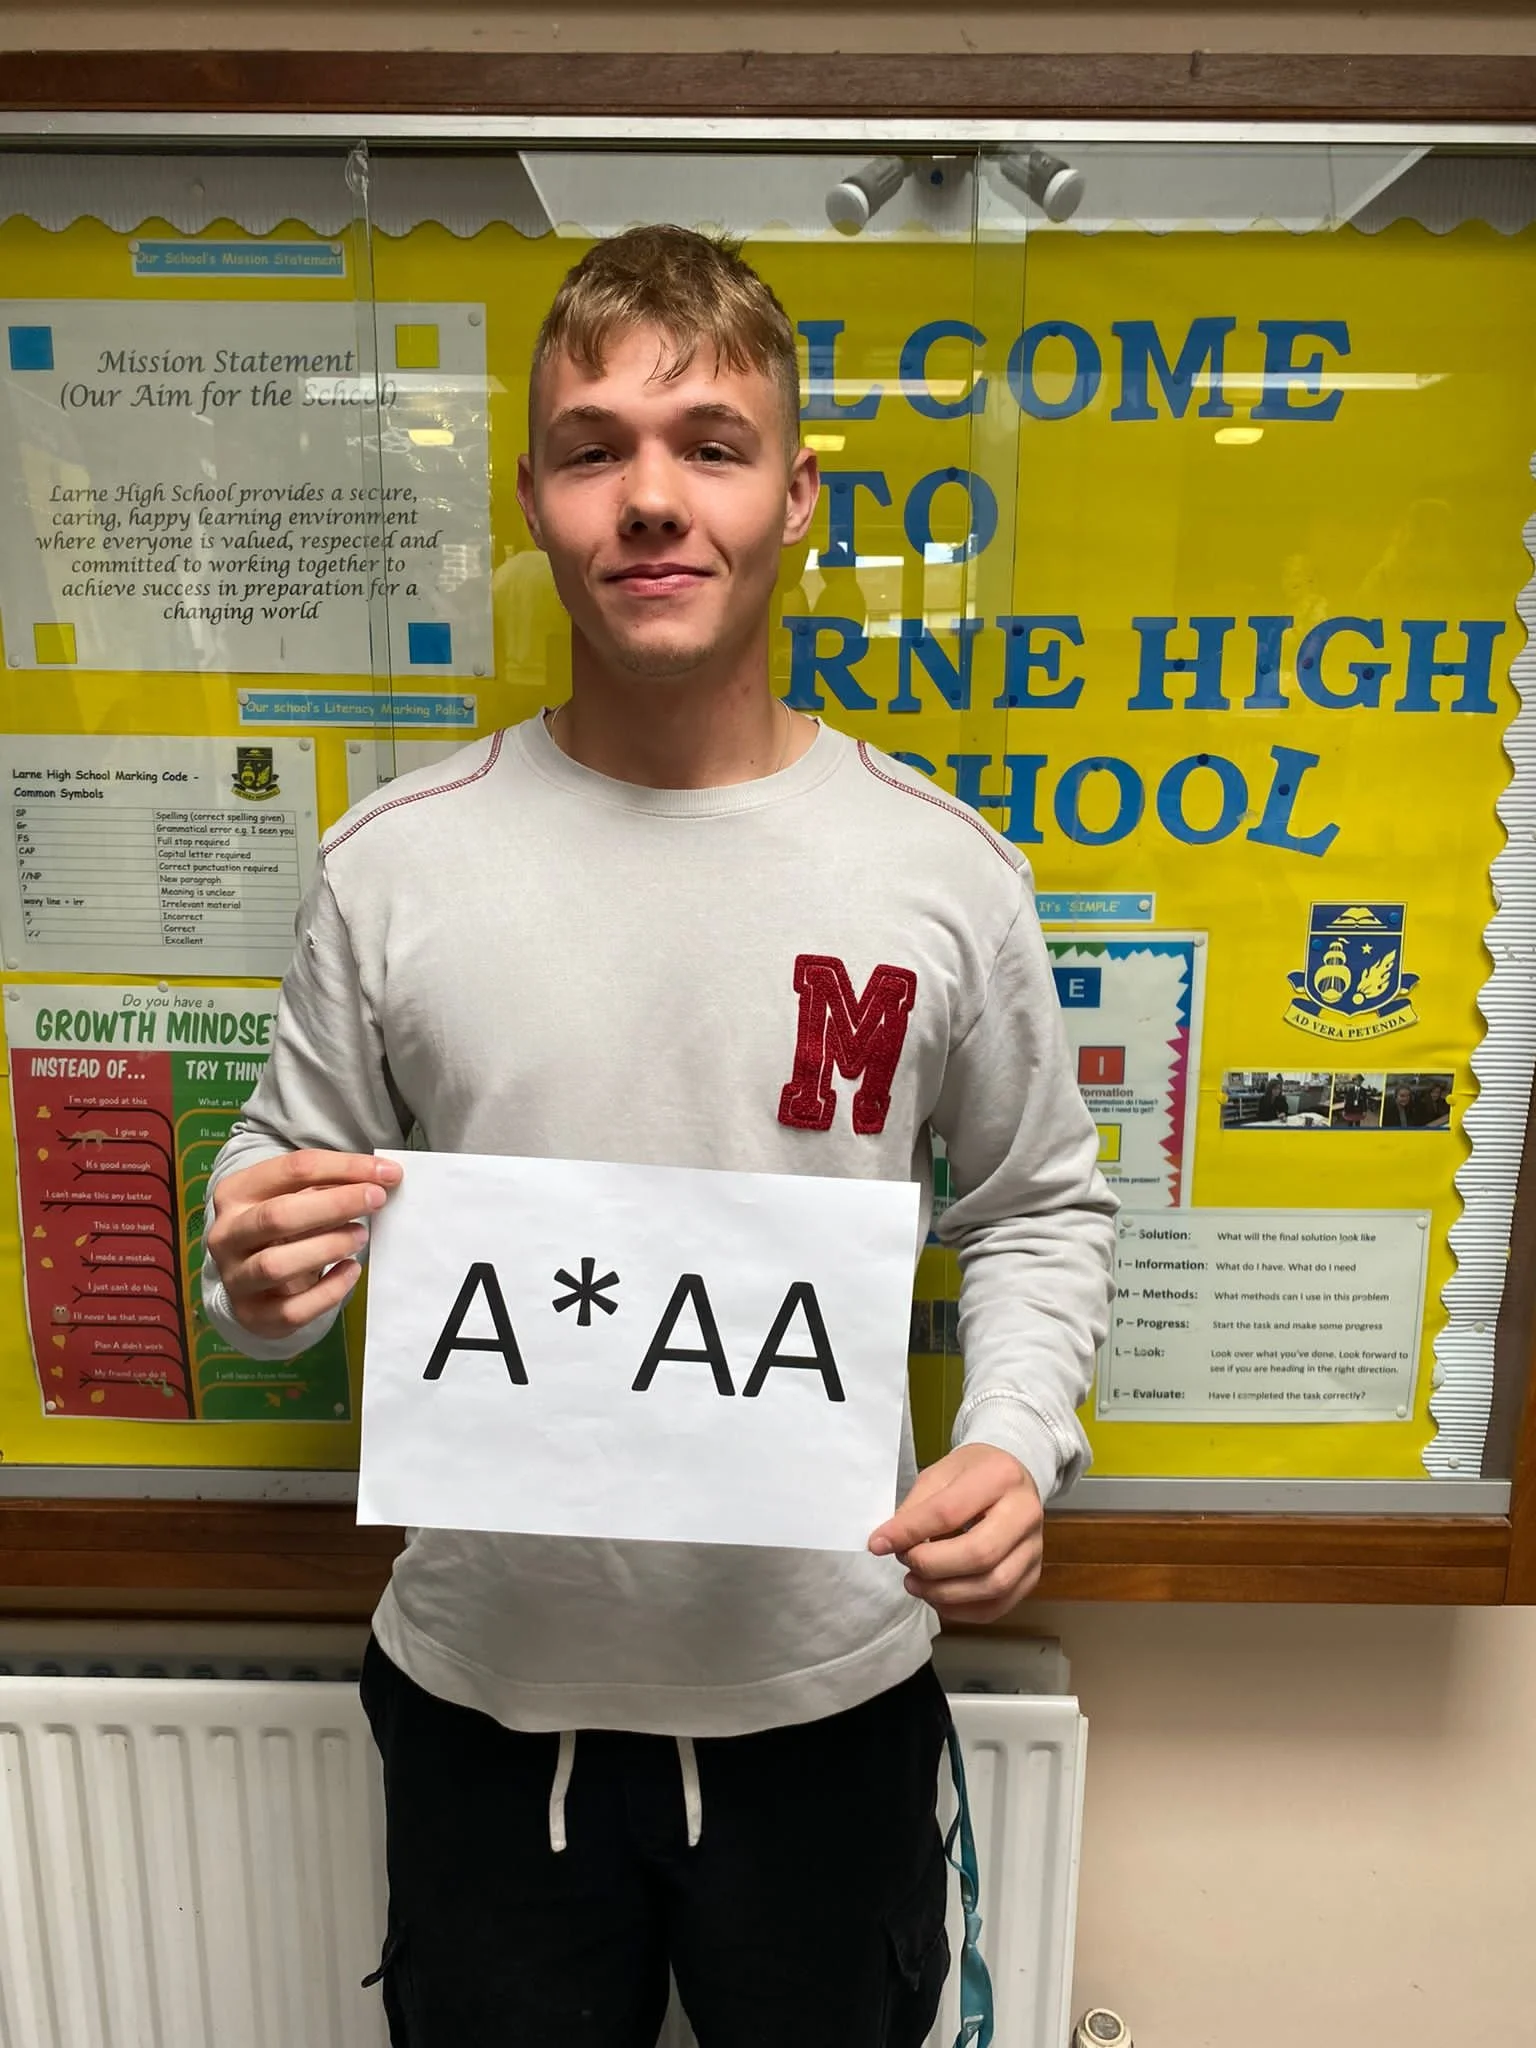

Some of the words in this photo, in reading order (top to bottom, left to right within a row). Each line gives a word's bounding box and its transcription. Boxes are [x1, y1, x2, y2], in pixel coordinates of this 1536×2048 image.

[136, 251, 159, 264] Our
[165, 252, 216, 265] School's
[222, 253, 268, 265] Mission
[273, 253, 341, 266] Statement
[97, 349, 205, 374] Mission
[213, 349, 356, 374] Statement
[798, 317, 1352, 422] LCOME
[60, 382, 122, 410] (Our
[130, 383, 192, 407] Aim
[196, 380, 242, 415] for
[249, 380, 292, 407] the
[303, 380, 397, 409] School)
[49, 485, 108, 502] Larne
[114, 483, 166, 507] High
[171, 482, 237, 502] School
[235, 482, 324, 507] provides
[331, 488, 344, 501] a
[350, 487, 417, 503] secure,
[52, 510, 121, 531] caring,
[129, 507, 191, 531] happy
[199, 507, 282, 531] learning
[289, 508, 419, 525] environment
[820, 466, 999, 568] TO
[36, 531, 96, 550] where
[103, 535, 192, 555] everyone
[200, 533, 214, 549] is
[221, 530, 293, 550] valued,
[300, 530, 398, 554] respected
[400, 530, 443, 549] and
[71, 554, 181, 573] committed
[183, 558, 202, 573] to
[209, 554, 290, 578] working
[298, 554, 379, 578] together
[387, 557, 405, 573] to
[62, 578, 136, 596] achieve
[142, 583, 210, 596] success
[218, 580, 238, 596] in
[240, 580, 364, 601] preparation
[367, 577, 400, 601] for
[406, 583, 418, 596] a
[163, 601, 253, 625] changing
[261, 601, 323, 619] world
[782, 615, 1085, 714] RNE
[1127, 615, 1505, 715] HIGH
[246, 702, 268, 713] Our
[273, 702, 320, 714] school's
[325, 702, 375, 717] Literacy
[381, 704, 430, 718] Marking
[435, 704, 469, 718] Policy
[12, 769, 42, 779] Larne
[47, 769, 72, 782] High
[75, 770, 110, 781] School
[115, 771, 158, 784] Marking
[162, 771, 188, 782] Code
[14, 788, 56, 798] Common
[60, 788, 104, 800] Symbols
[887, 745, 1342, 858] HOOL
[156, 812, 188, 822] Spelling
[190, 812, 225, 821] (correct
[227, 812, 258, 824] spelling
[260, 813, 285, 824] given)
[17, 834, 29, 842] FS
[158, 837, 173, 846] Full
[175, 838, 192, 848] stop
[194, 838, 231, 848] required
[18, 846, 35, 855] CAP
[158, 849, 186, 860] Capital
[188, 850, 214, 859] letter
[215, 851, 252, 861] required
[159, 862, 191, 871] Correct
[193, 863, 241, 873] punctuation
[242, 864, 278, 874] required
[162, 900, 204, 909] Irrelevant
[206, 900, 242, 909] material
[1040, 901, 1060, 913] It's
[163, 912, 203, 921] Incorrect
[165, 936, 203, 945] Excellent
[1068, 978, 1085, 998] E
[122, 993, 142, 1008] Do
[146, 997, 169, 1010] you
[173, 995, 202, 1009] have
[208, 999, 215, 1009] a
[35, 1008, 158, 1044] GROWTH
[166, 1011, 278, 1046] MINDSE
[1293, 1013, 1309, 1026] AD
[1312, 1021, 1343, 1038] VERA
[1348, 1015, 1406, 1038] PETENDA
[777, 953, 917, 1136] M
[31, 1056, 100, 1079] INSTEAD
[107, 1059, 146, 1080] OF...
[185, 1060, 219, 1081] TRY
[224, 1061, 268, 1081] THIN
[1098, 1055, 1105, 1077] I
[1081, 1087, 1134, 1098] formation
[83, 1097, 97, 1105] not
[99, 1096, 119, 1107] good
[121, 1097, 130, 1105] at
[132, 1096, 148, 1105] this
[120, 1128, 137, 1138] give
[139, 1130, 150, 1138] up
[100, 1160, 120, 1171] good
[122, 1161, 151, 1172] enough
[1119, 1228, 1127, 1240] S
[1139, 1228, 1193, 1240] Solution:
[1217, 1232, 1242, 1241] What
[1244, 1231, 1260, 1241] will
[1262, 1232, 1278, 1241] the
[1279, 1232, 1300, 1241] final
[1301, 1232, 1338, 1242] solution
[1339, 1232, 1359, 1242] look
[1360, 1233, 1377, 1242] like
[1118, 1259, 1122, 1269] I
[1135, 1259, 1209, 1271] Information:
[1215, 1262, 1241, 1271] What
[1242, 1262, 1255, 1271] do
[1261, 1263, 1286, 1272] have.
[1288, 1263, 1313, 1272] What
[1314, 1263, 1327, 1272] do
[1334, 1263, 1357, 1272] need
[1117, 1288, 1130, 1299] M
[1142, 1288, 1199, 1300] Methods:
[1116, 1318, 1124, 1329] P
[1136, 1318, 1190, 1331] Progress:
[1212, 1320, 1234, 1330] Start
[1236, 1320, 1251, 1330] the
[1253, 1321, 1272, 1330] task
[1273, 1321, 1291, 1330] and
[1292, 1321, 1317, 1330] make
[1319, 1322, 1343, 1331] some
[1345, 1322, 1383, 1332] progress
[1115, 1346, 1121, 1357] L
[1134, 1346, 1166, 1358] Look:
[1113, 1388, 1120, 1399] E
[1133, 1388, 1186, 1400] Evaluate:
